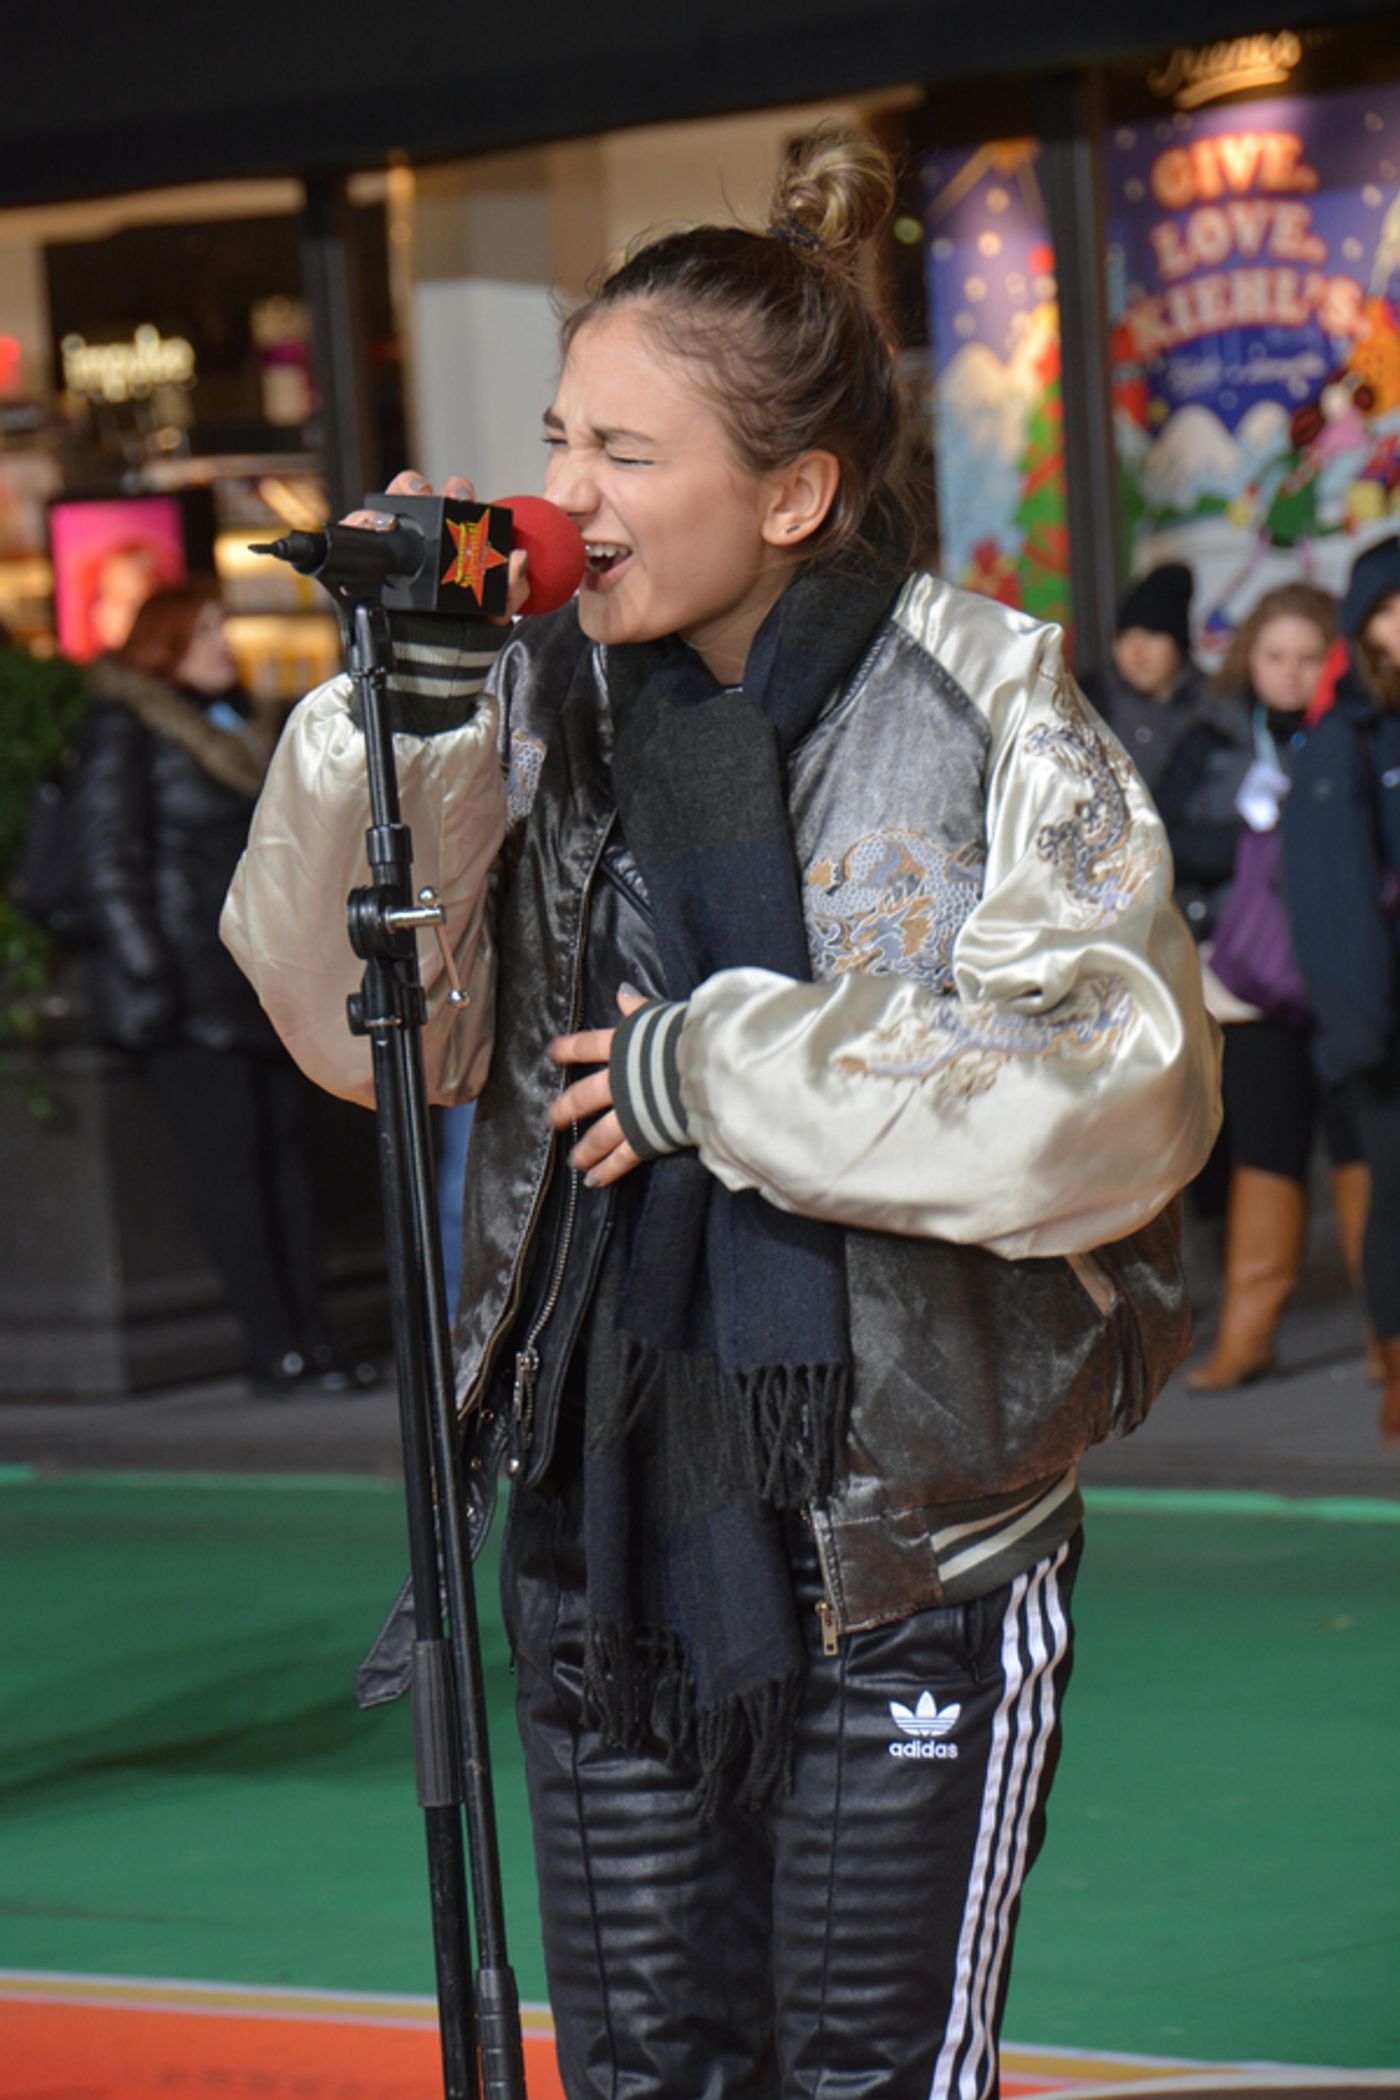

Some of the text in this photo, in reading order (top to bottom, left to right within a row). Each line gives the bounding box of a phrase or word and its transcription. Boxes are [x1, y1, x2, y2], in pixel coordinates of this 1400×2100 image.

[1151, 131, 1319, 209] GIVE.
[1150, 199, 1328, 281] LOVE.
[889, 1740, 958, 1758] adidas
